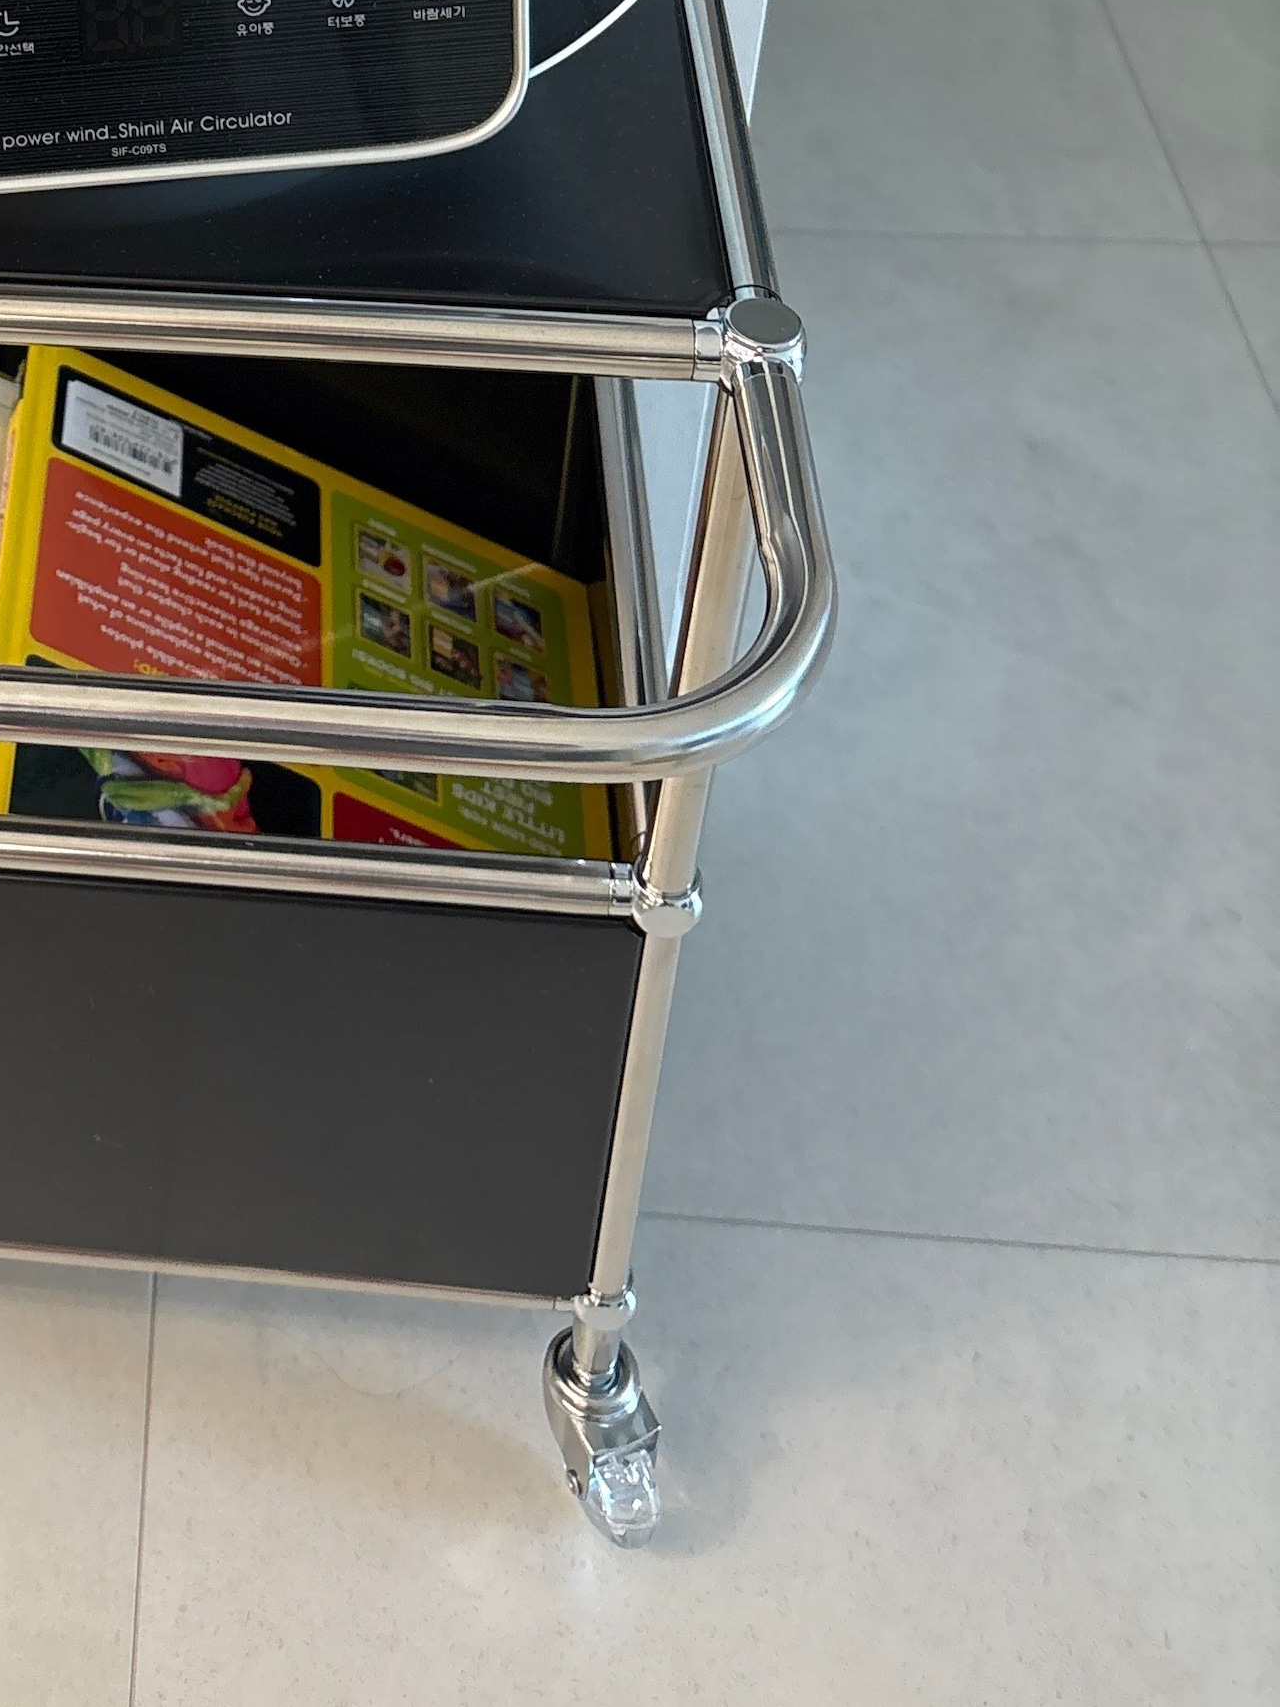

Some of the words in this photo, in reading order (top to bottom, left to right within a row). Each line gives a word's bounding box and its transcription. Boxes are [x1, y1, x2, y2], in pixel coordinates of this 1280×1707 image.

[327, 13, 366, 29] 터보풍
[412, 5, 467, 21] 바람세기
[235, 21, 275, 37] 유아풍
[2, 132, 61, 152] power
[170, 117, 194, 135] Air
[199, 110, 293, 132] Circulator
[110, 143, 168, 158] SIF-C09TS
